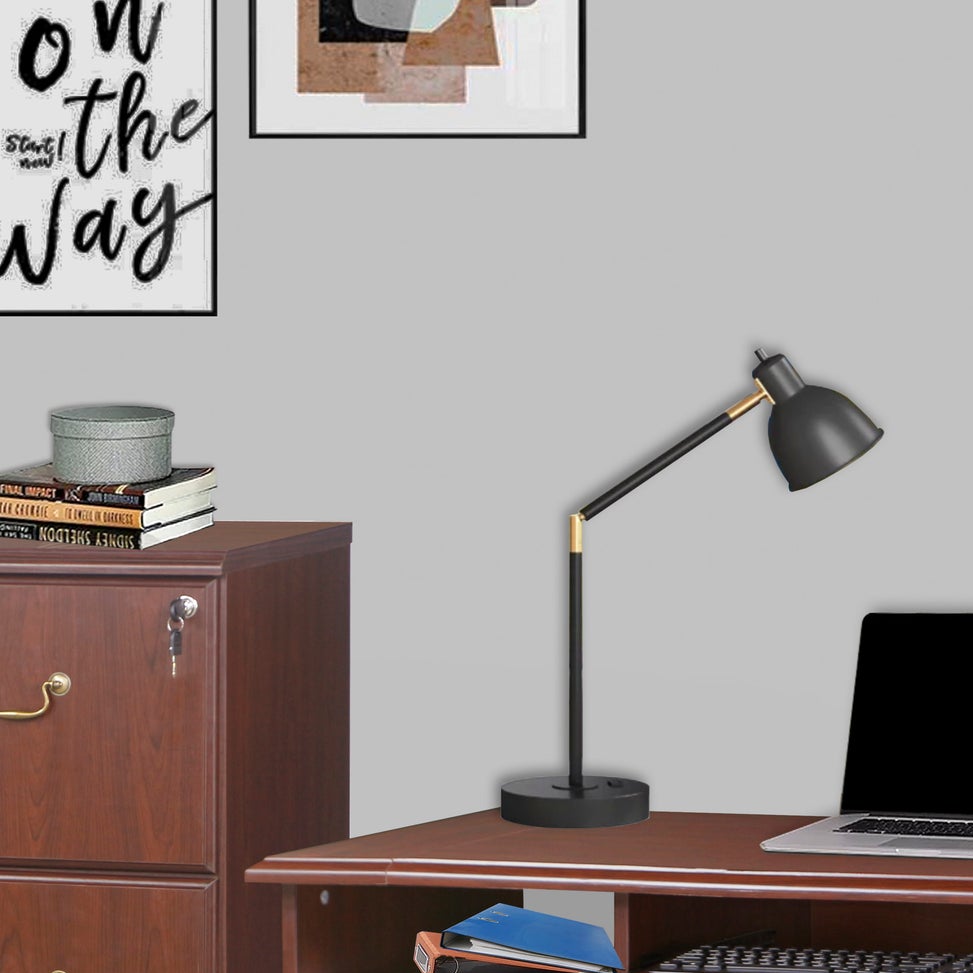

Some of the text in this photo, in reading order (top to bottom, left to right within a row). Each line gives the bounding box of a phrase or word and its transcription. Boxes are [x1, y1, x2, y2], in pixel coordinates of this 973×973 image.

[63, 70, 214, 179] the
[0, 483, 56, 499] FINAL IMPACT
[103, 511, 134, 526] DARKNESS
[39, 526, 135, 550] SIDNEY SHELDON
